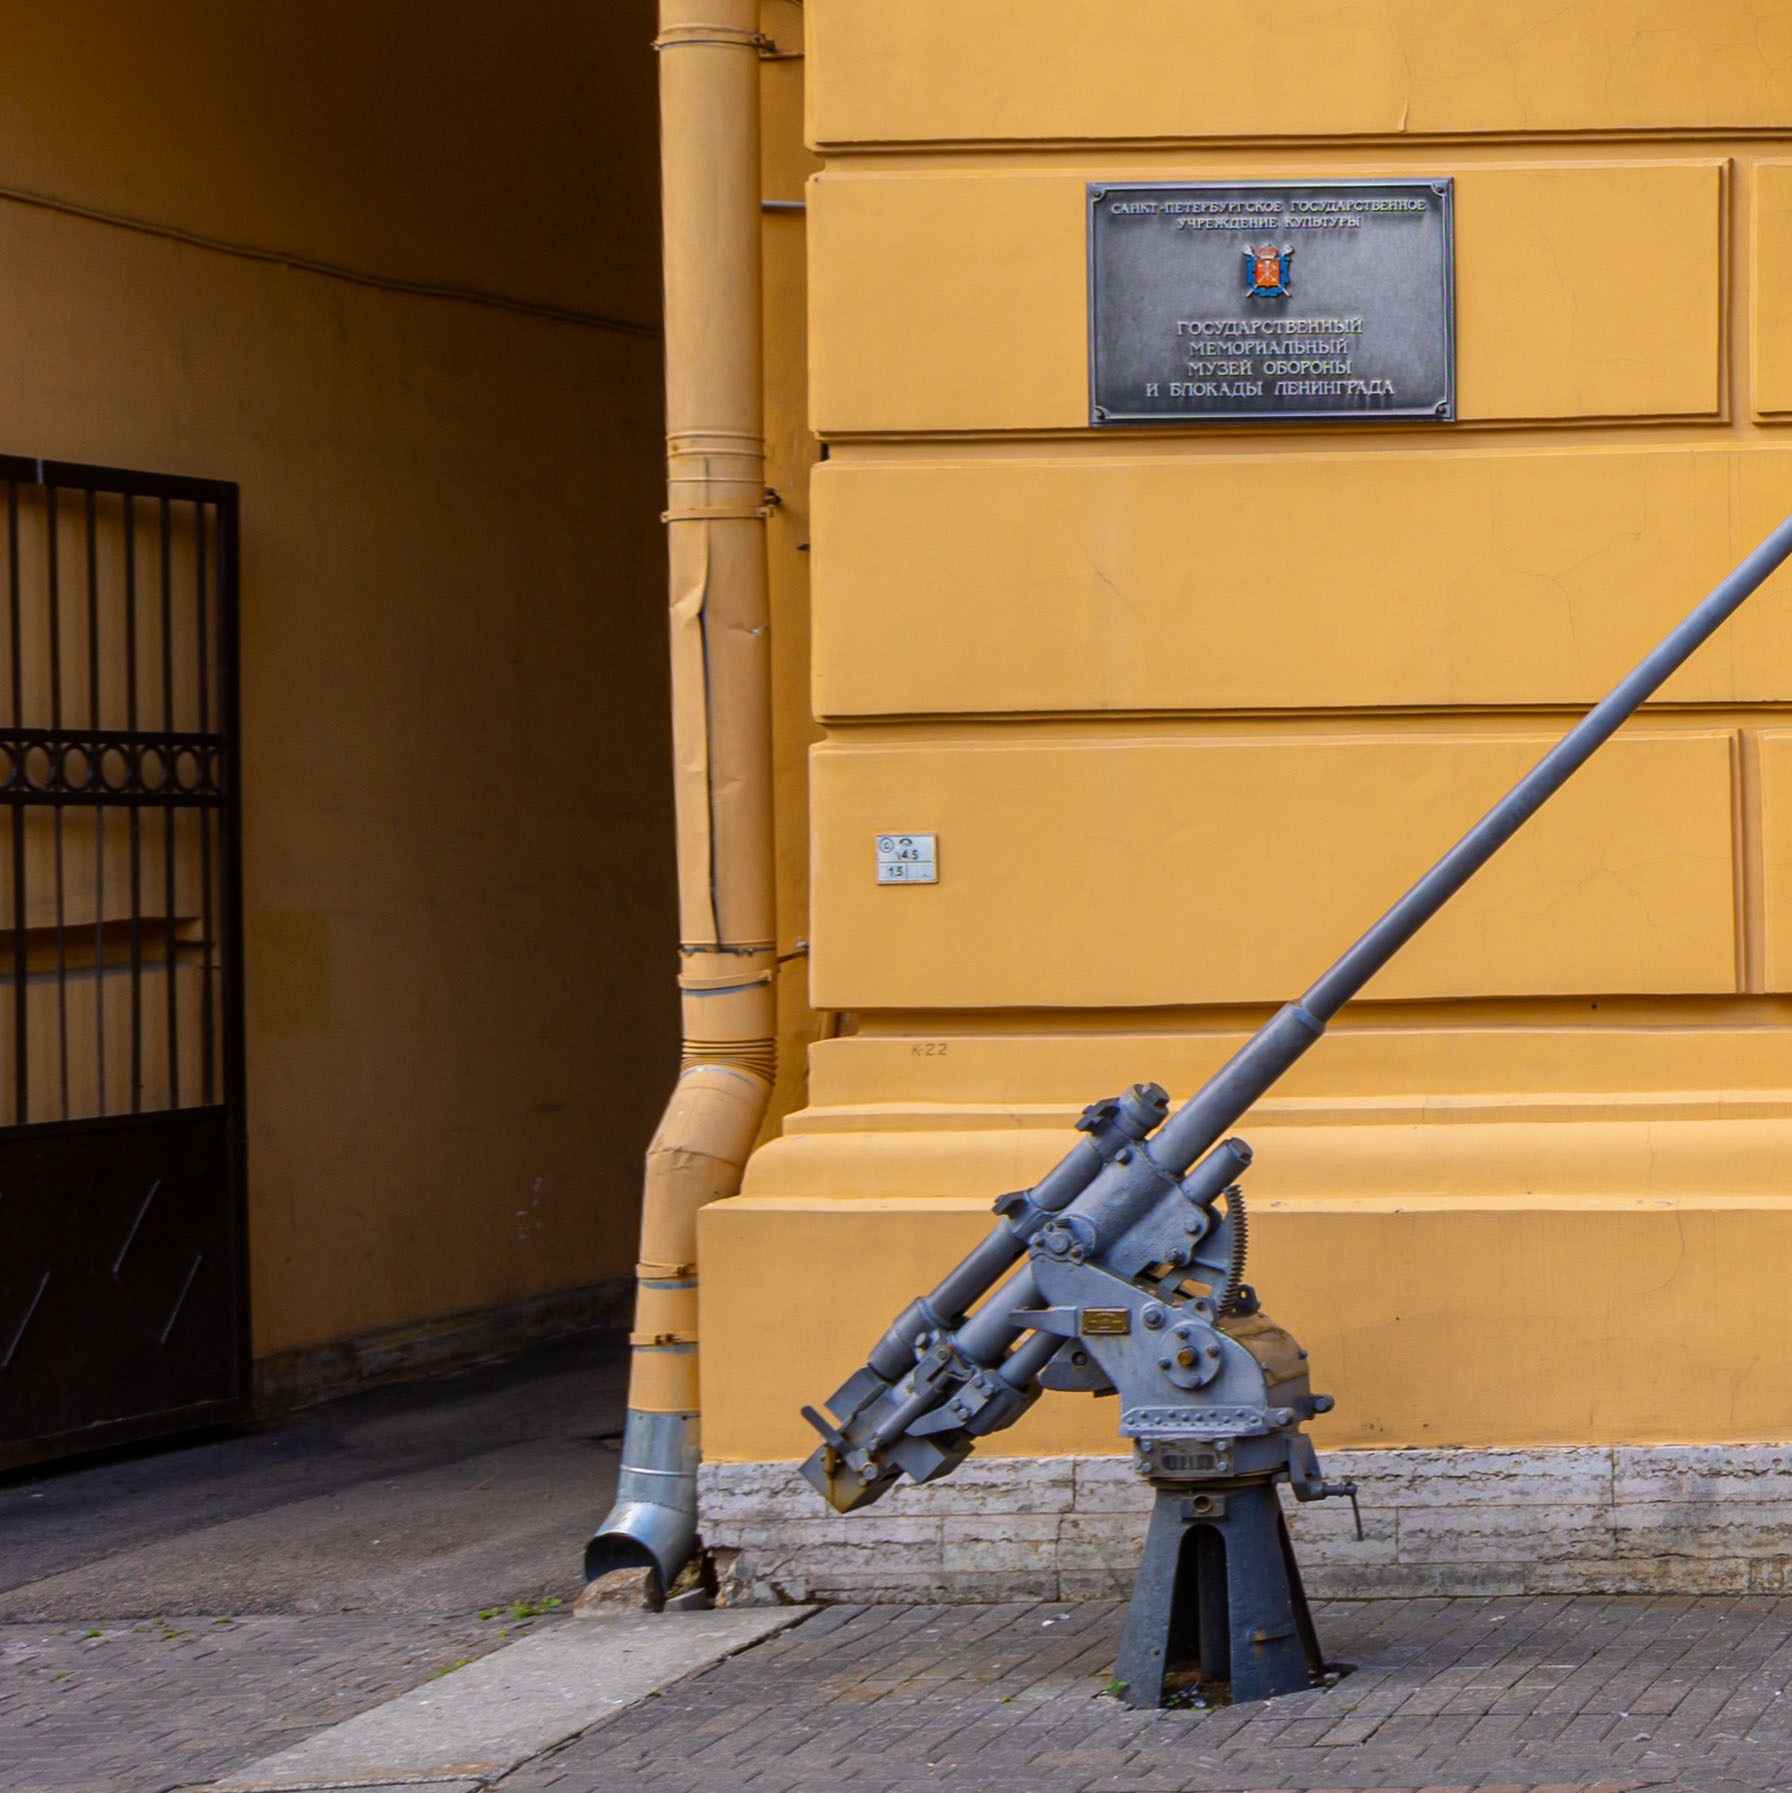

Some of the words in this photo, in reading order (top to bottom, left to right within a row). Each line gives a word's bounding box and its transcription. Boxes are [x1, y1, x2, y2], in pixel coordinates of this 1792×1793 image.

[1289, 199, 1427, 213] ГОСУДАРСТВЕННОЕ
[1176, 216, 1278, 230] УЧРЕЖДЕНИЕ
[1284, 215, 1361, 229] КУЛЬТУРЫ
[1176, 317, 1364, 337] ГОСУДАРСТВЕННЫЙ
[1188, 338, 1350, 357] МЕМОРИАЛЬНЫЙ
[1187, 358, 1253, 377] МУЗЕЙ
[1263, 359, 1353, 376] ОБОРОНЫ
[1145, 382, 1160, 398] И
[1170, 381, 1264, 399] БЛОКАДЫ
[1274, 379, 1396, 398] ЛЕНИНГРАДА
